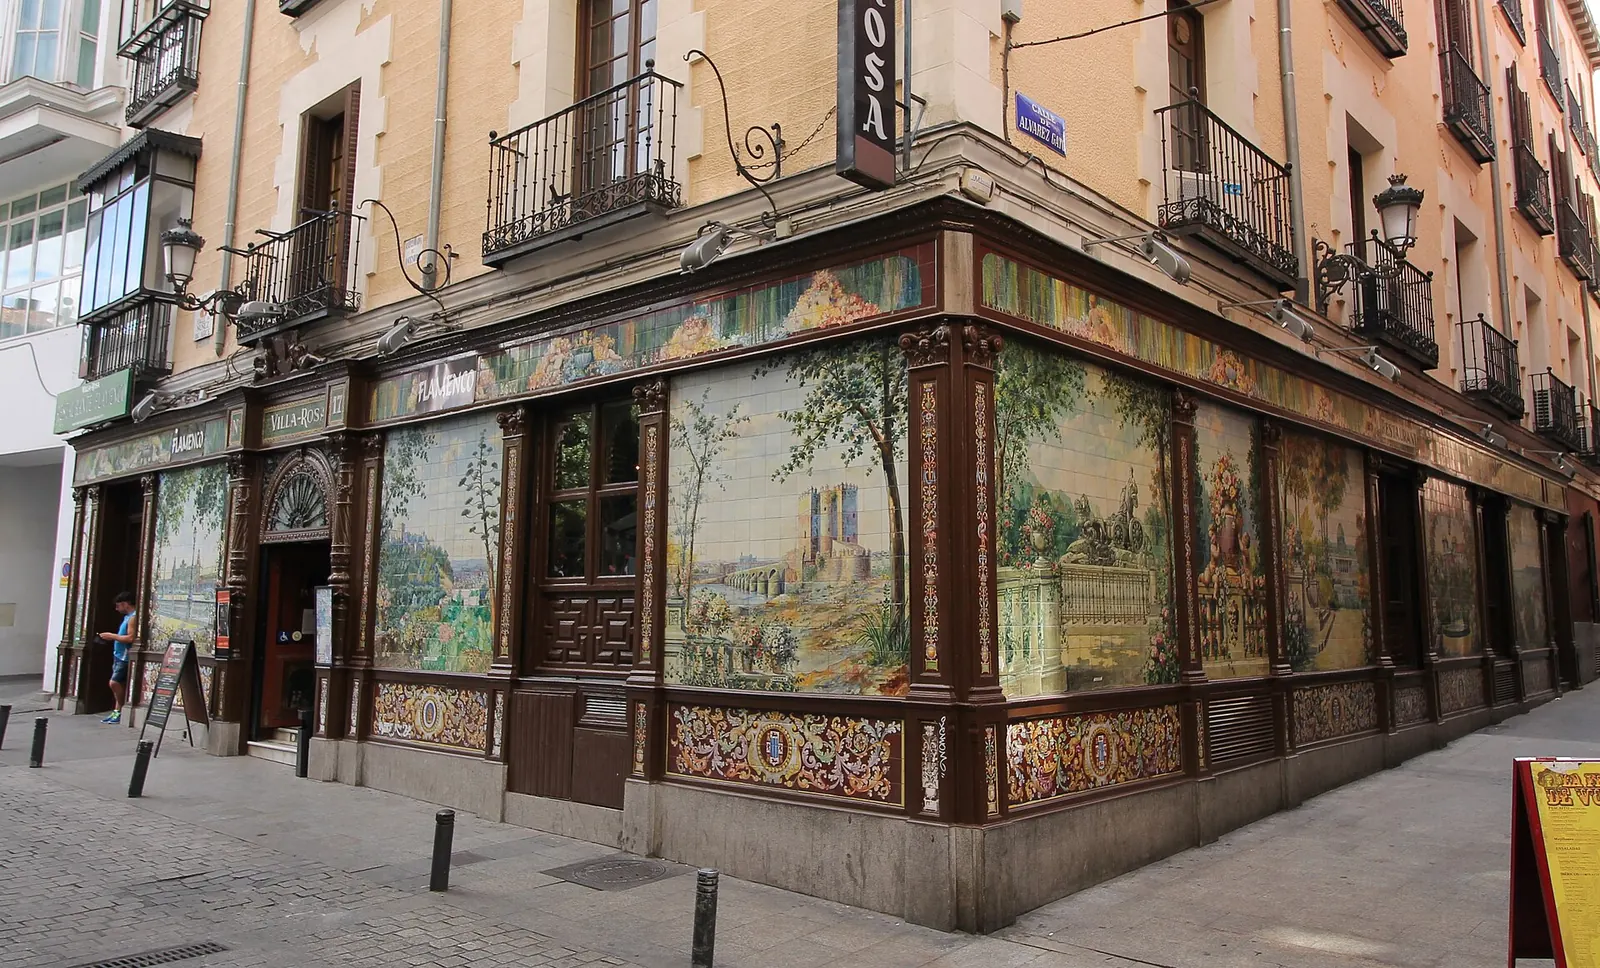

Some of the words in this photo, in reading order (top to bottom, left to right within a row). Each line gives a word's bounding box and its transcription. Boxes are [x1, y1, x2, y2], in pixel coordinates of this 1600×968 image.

[863, 0, 888, 140] OSA
[1031, 103, 1057, 125] CALLE
[1040, 117, 1051, 129] DE
[1018, 115, 1051, 142] ALVAREZ
[418, 365, 476, 402] FLAMENCO
[332, 395, 343, 415] 17
[172, 428, 204, 454] FLAMENCO
[1544, 786, 1574, 806] DE
